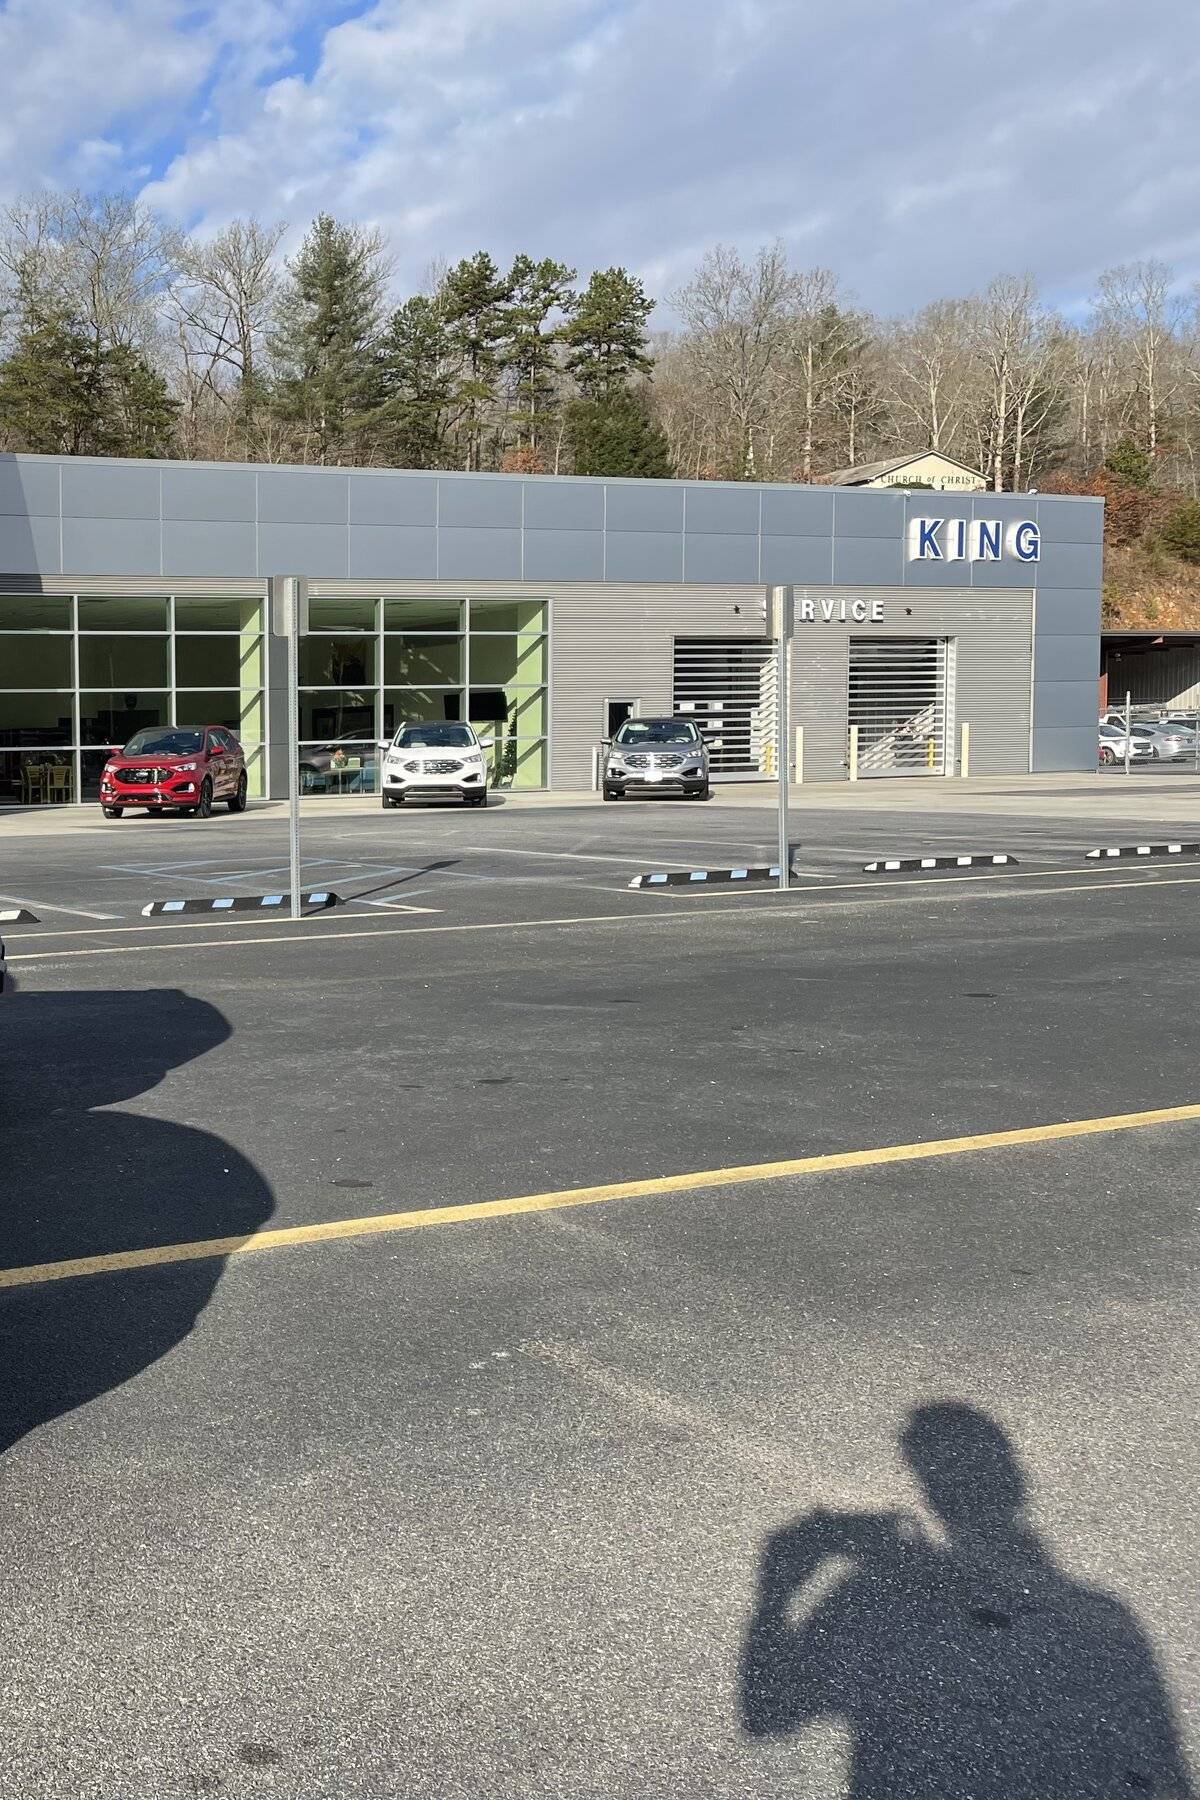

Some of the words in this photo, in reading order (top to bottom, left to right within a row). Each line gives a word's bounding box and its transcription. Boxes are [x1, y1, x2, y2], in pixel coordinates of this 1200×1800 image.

[880, 475, 921, 484] CHURCH
[941, 476, 975, 484] CHRIST
[910, 517, 1041, 562] KING
[761, 599, 885, 622] RVICE
